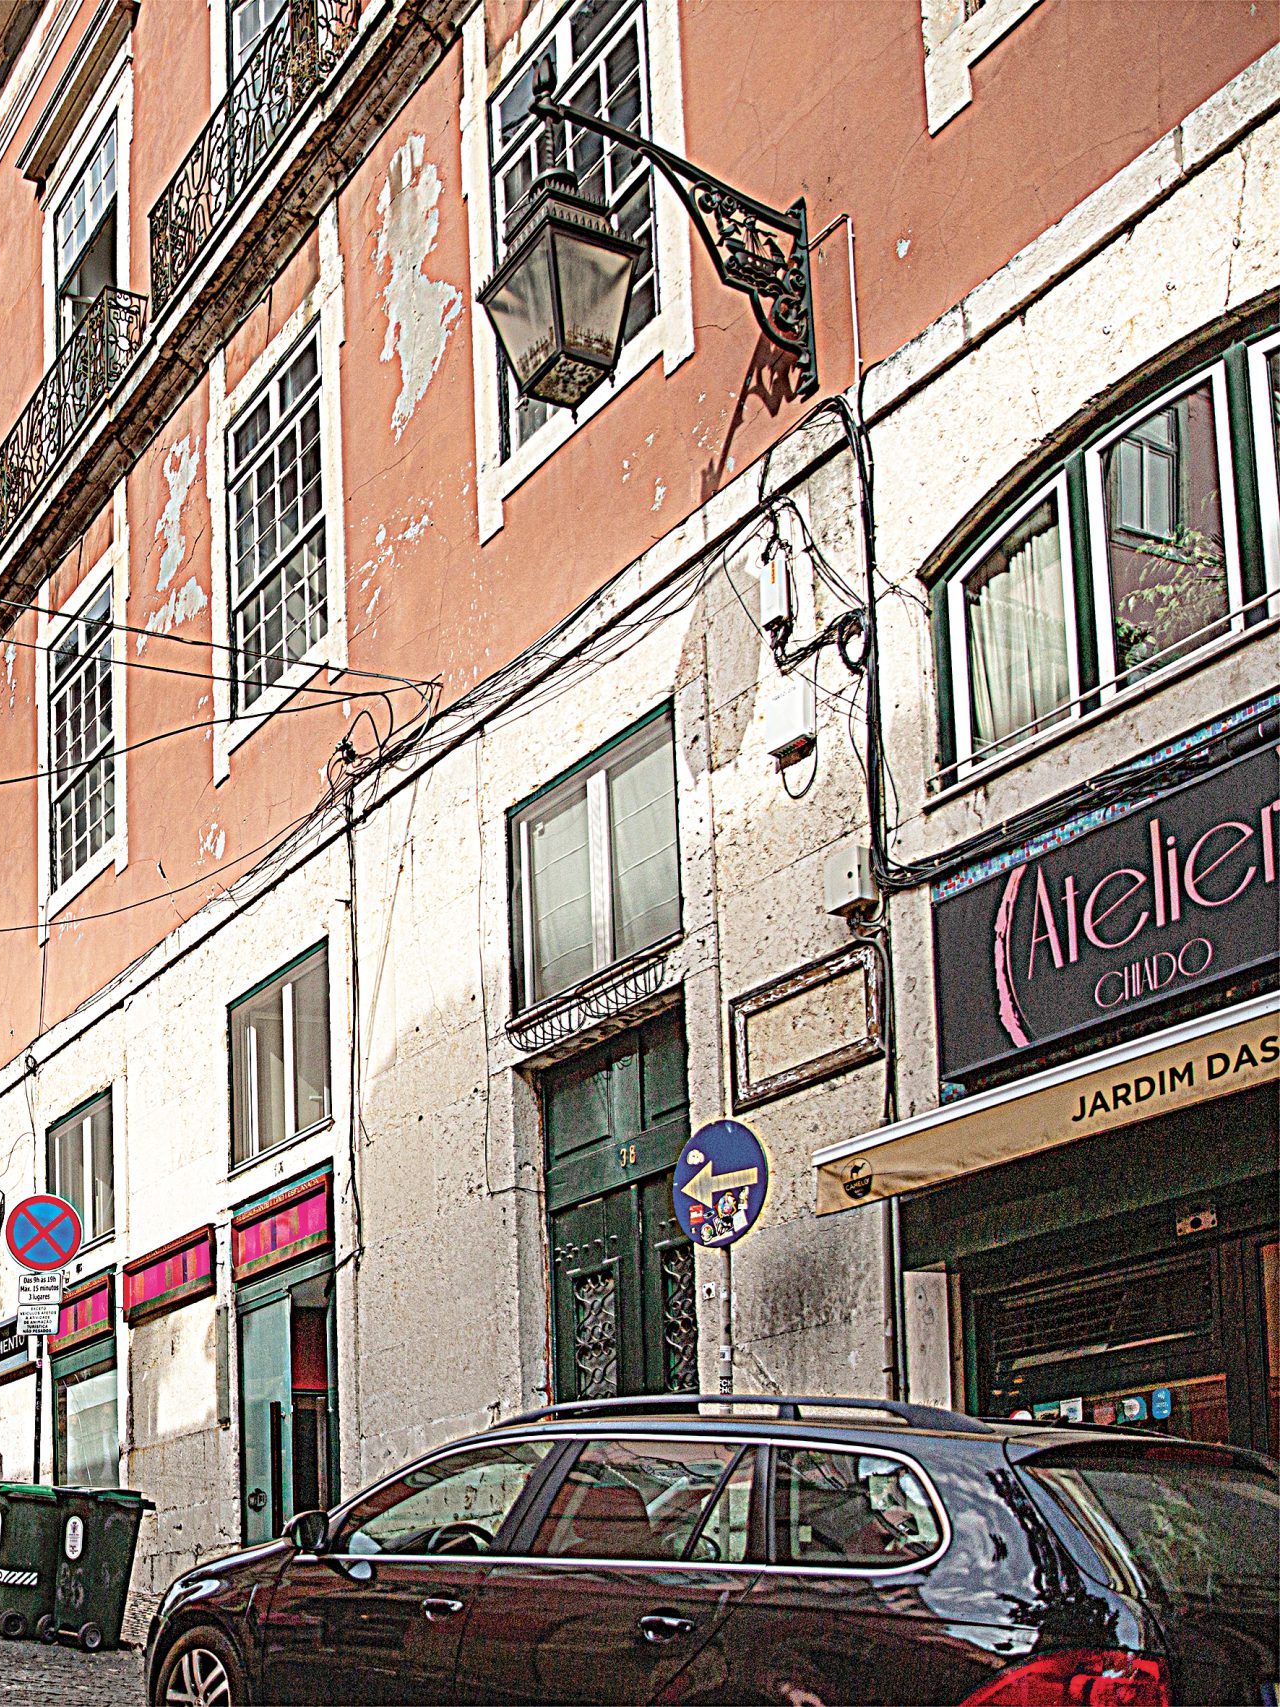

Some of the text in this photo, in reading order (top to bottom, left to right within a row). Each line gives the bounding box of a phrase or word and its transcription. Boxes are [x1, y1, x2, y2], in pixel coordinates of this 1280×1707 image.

[1028, 799, 1280, 980] Atelier
[1094, 938, 1213, 1008] CHIADO
[1071, 1035, 1280, 1122] JARDIM DAS
[620, 1145, 636, 1168] 38
